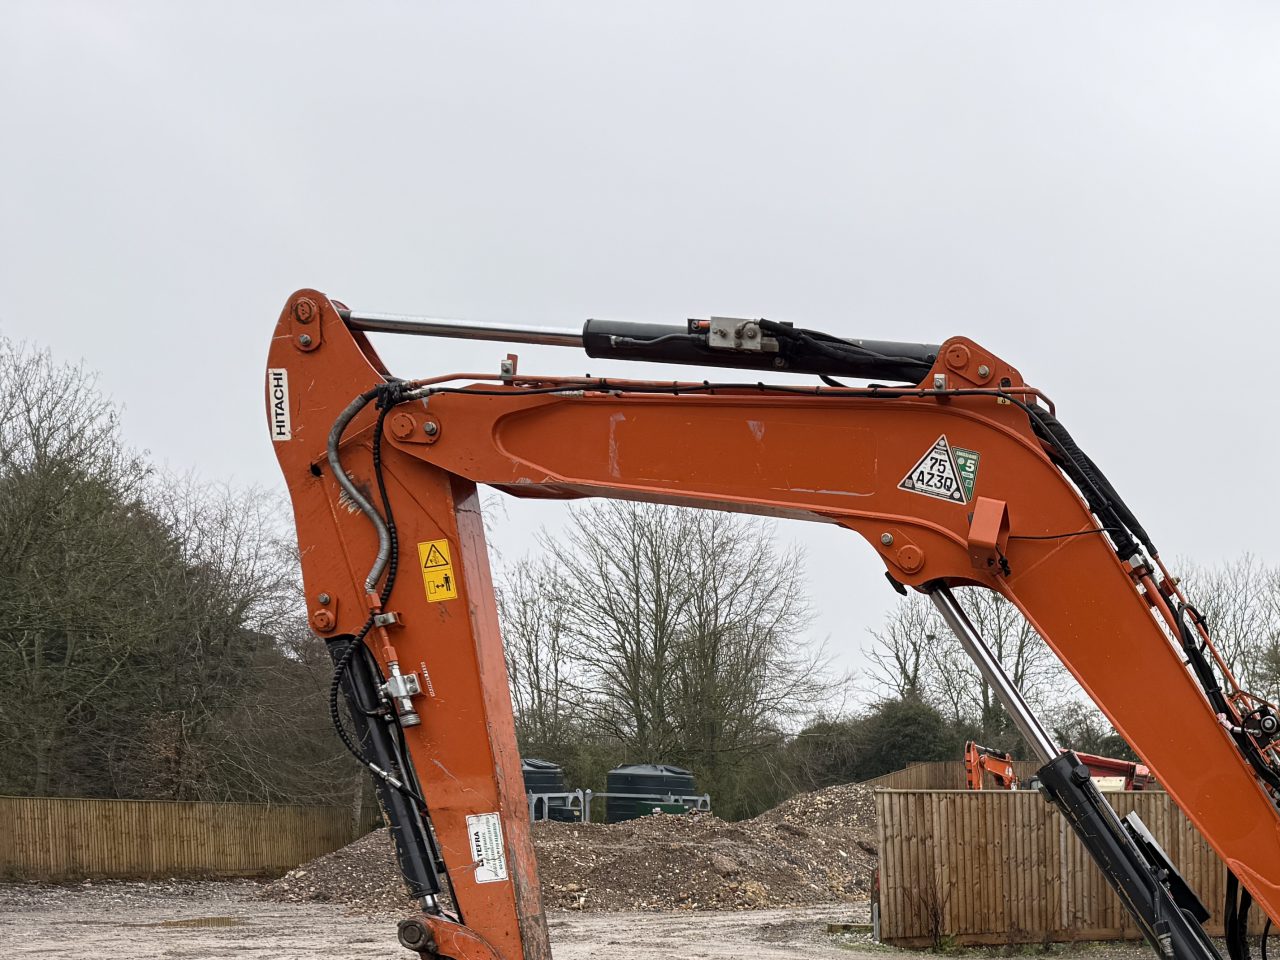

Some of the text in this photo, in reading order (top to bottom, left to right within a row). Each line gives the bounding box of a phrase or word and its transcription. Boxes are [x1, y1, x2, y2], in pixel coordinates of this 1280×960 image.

[273, 372, 286, 436] HITACHI
[929, 456, 948, 474] 75
[965, 459, 975, 472] 5
[915, 470, 954, 492] AZ3Q
[473, 831, 483, 858] TEFRA
